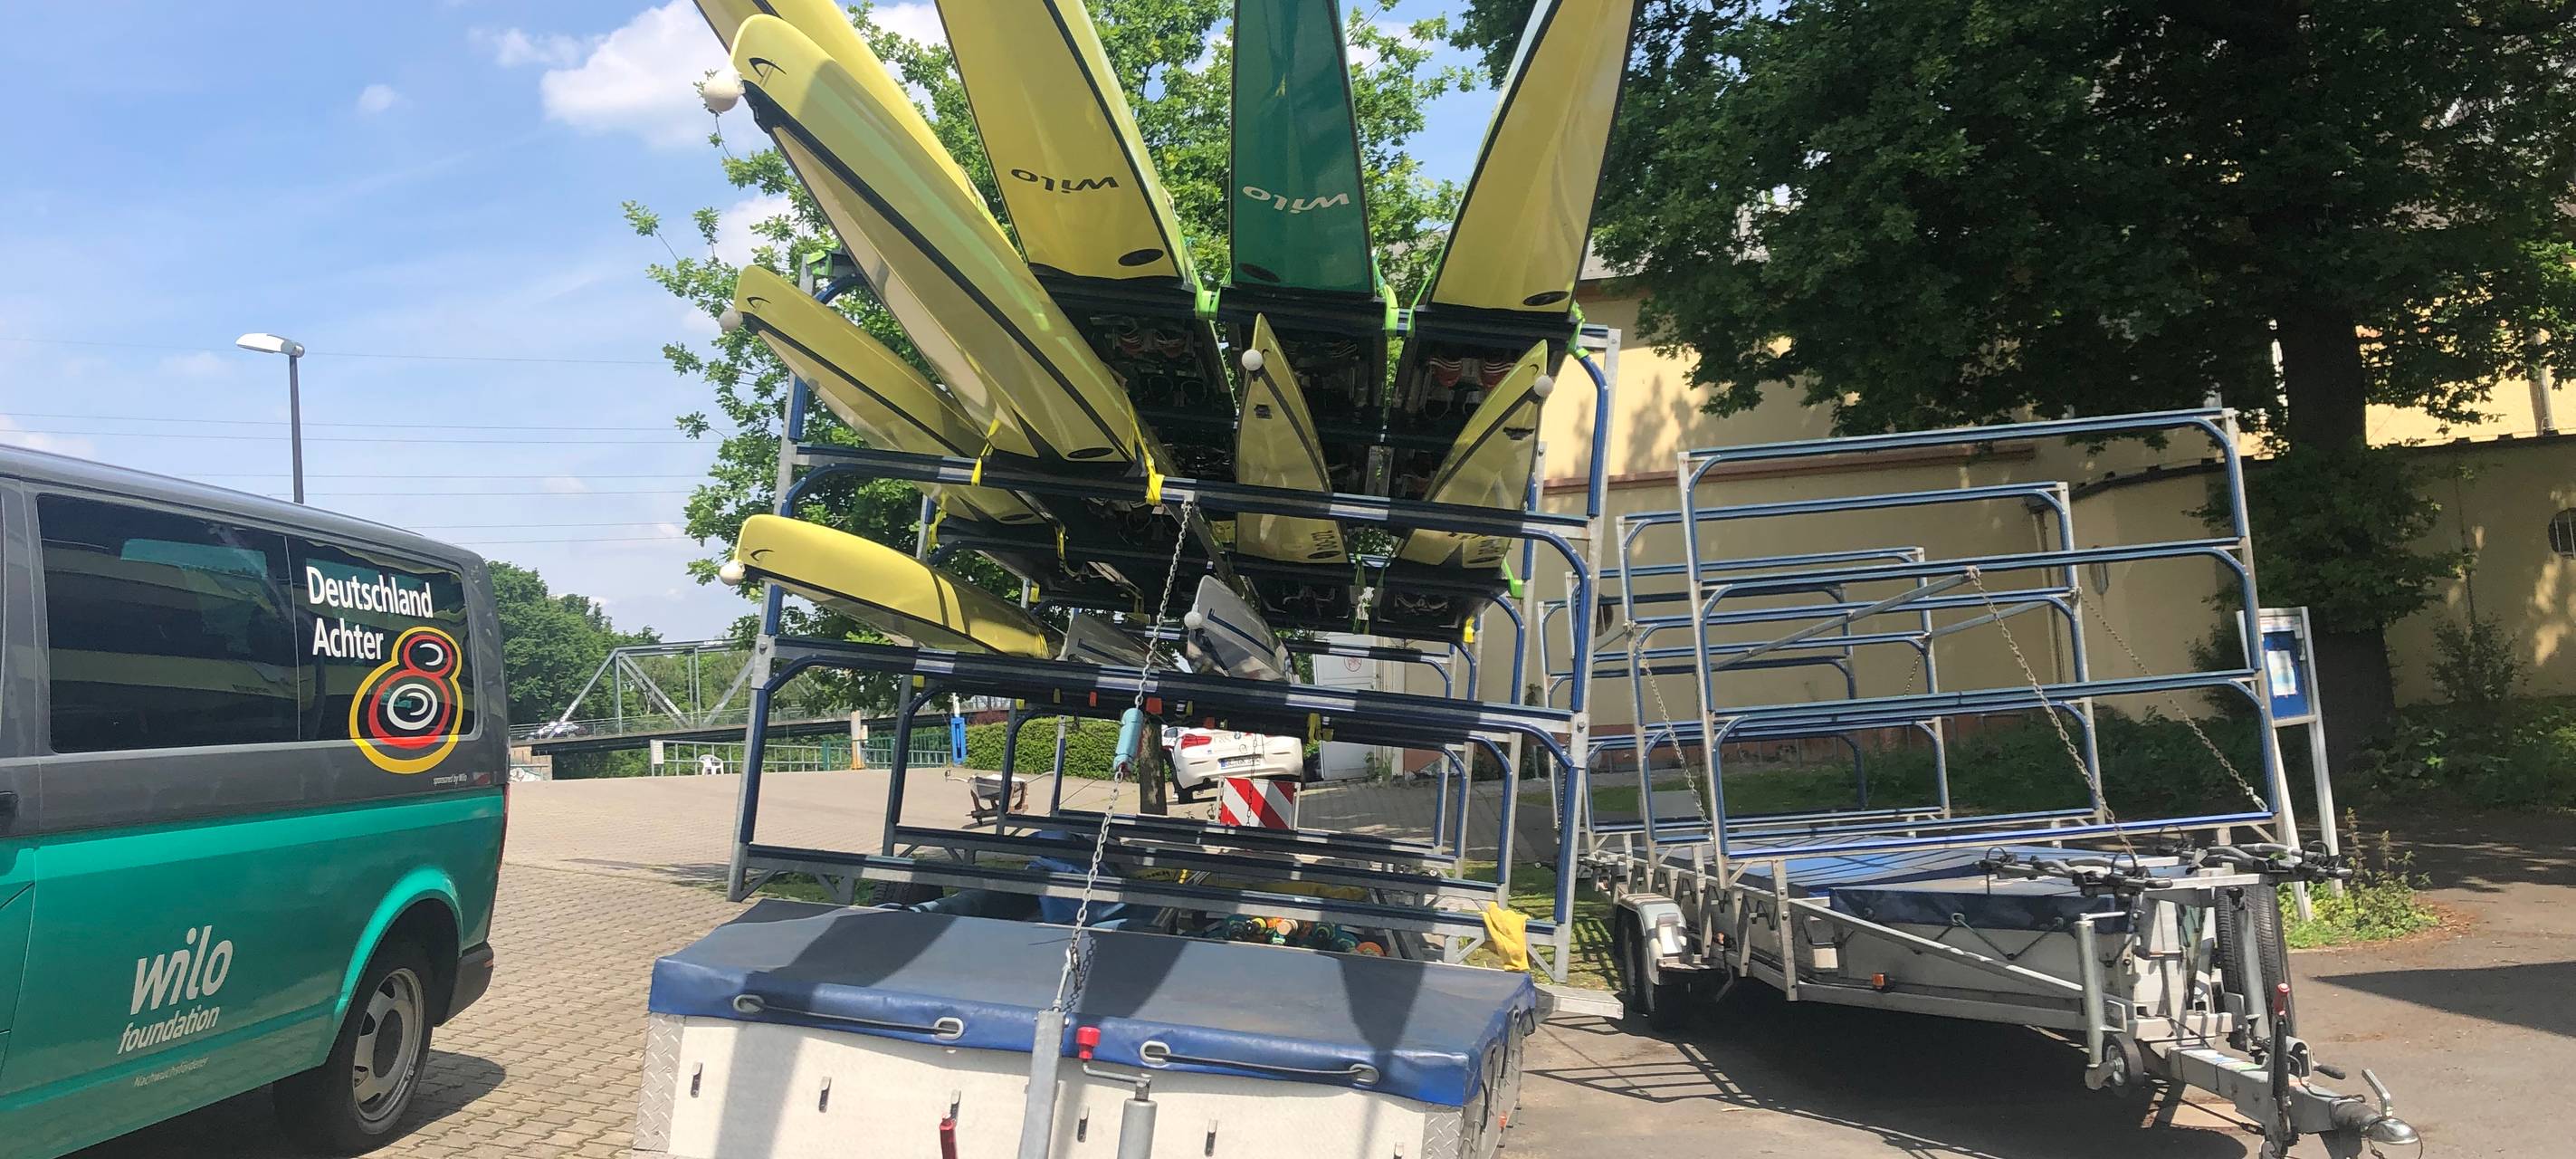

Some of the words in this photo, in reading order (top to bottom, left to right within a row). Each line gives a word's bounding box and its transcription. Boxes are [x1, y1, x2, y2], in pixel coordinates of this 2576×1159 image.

[1011, 168, 1120, 194] wilo
[1243, 186, 1350, 214] wilo
[306, 566, 434, 618] Deutschland
[312, 618, 384, 660] Achter
[130, 924, 234, 1015] wilo
[117, 1004, 220, 1055] foundation
